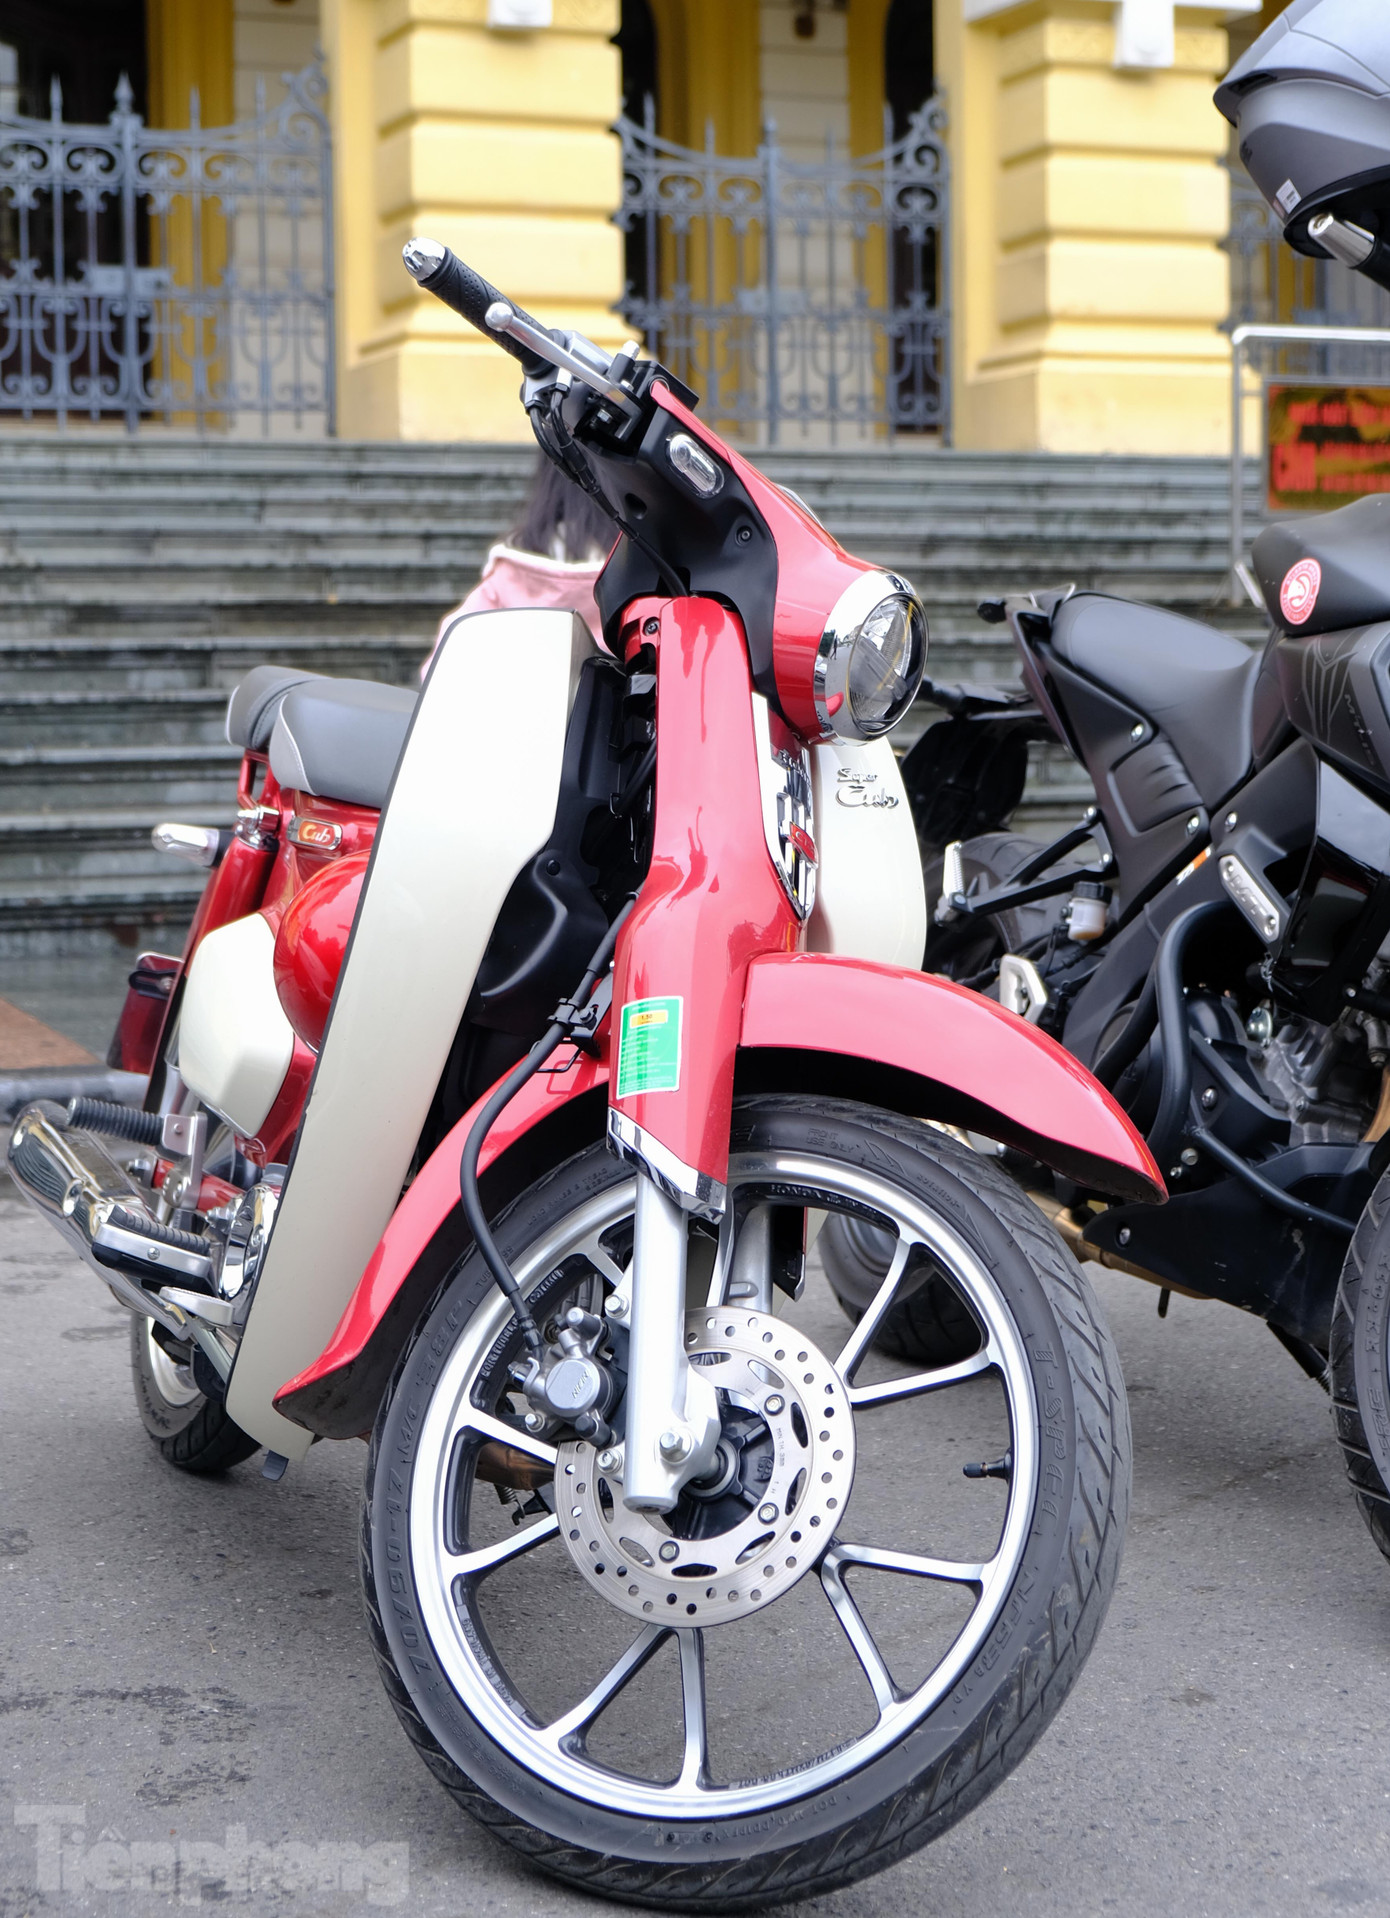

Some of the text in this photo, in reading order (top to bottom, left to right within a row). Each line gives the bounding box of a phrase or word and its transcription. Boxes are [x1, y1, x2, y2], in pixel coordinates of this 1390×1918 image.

[836, 786, 899, 809] Cub
[302, 824, 331, 843] Cub
[806, 1127, 839, 1141] FRONT
[804, 1136, 855, 1155] USE ONLY
[811, 1793, 837, 1815] DOT
